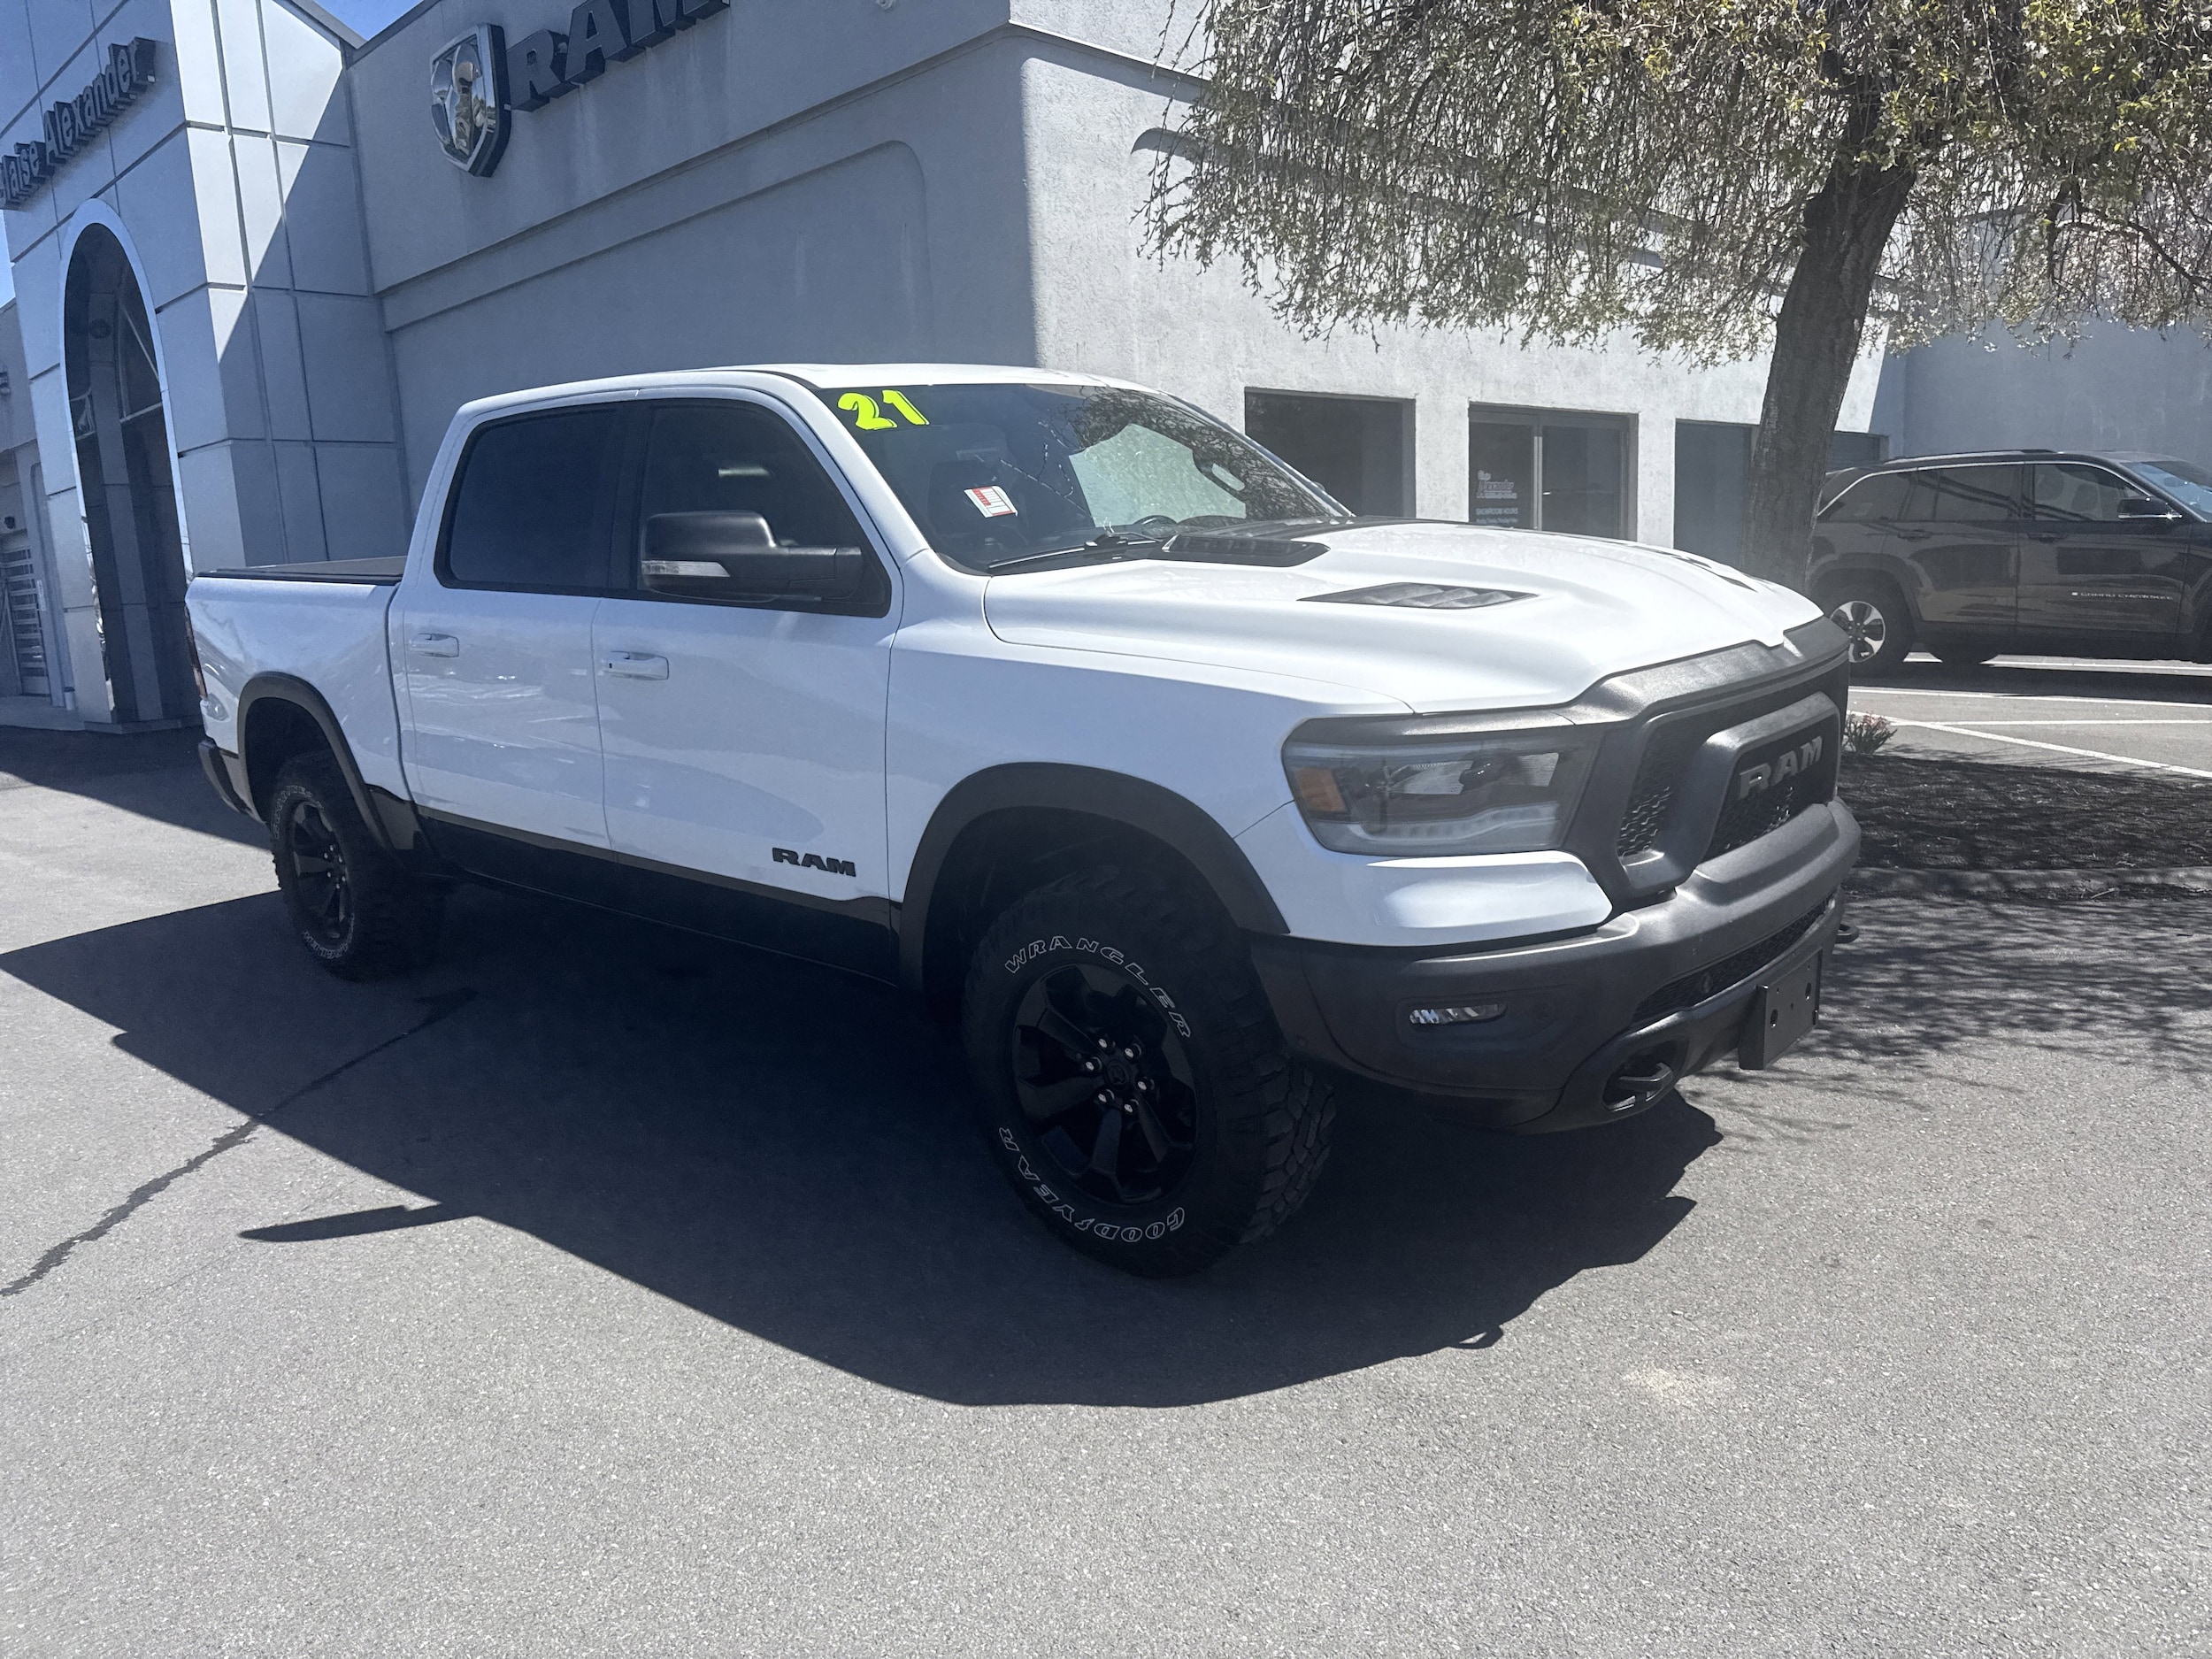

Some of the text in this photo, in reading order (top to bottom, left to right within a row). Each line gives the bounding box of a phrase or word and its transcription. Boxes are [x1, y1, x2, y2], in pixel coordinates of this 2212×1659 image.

[44, 37, 155, 173] Alexander
[837, 389, 929, 430] 21
[1739, 735, 1824, 800] RAM
[772, 847, 856, 877] RAM
[1004, 935, 1191, 1038] WRANGLER
[998, 1126, 1185, 1243] GOODYEAR
